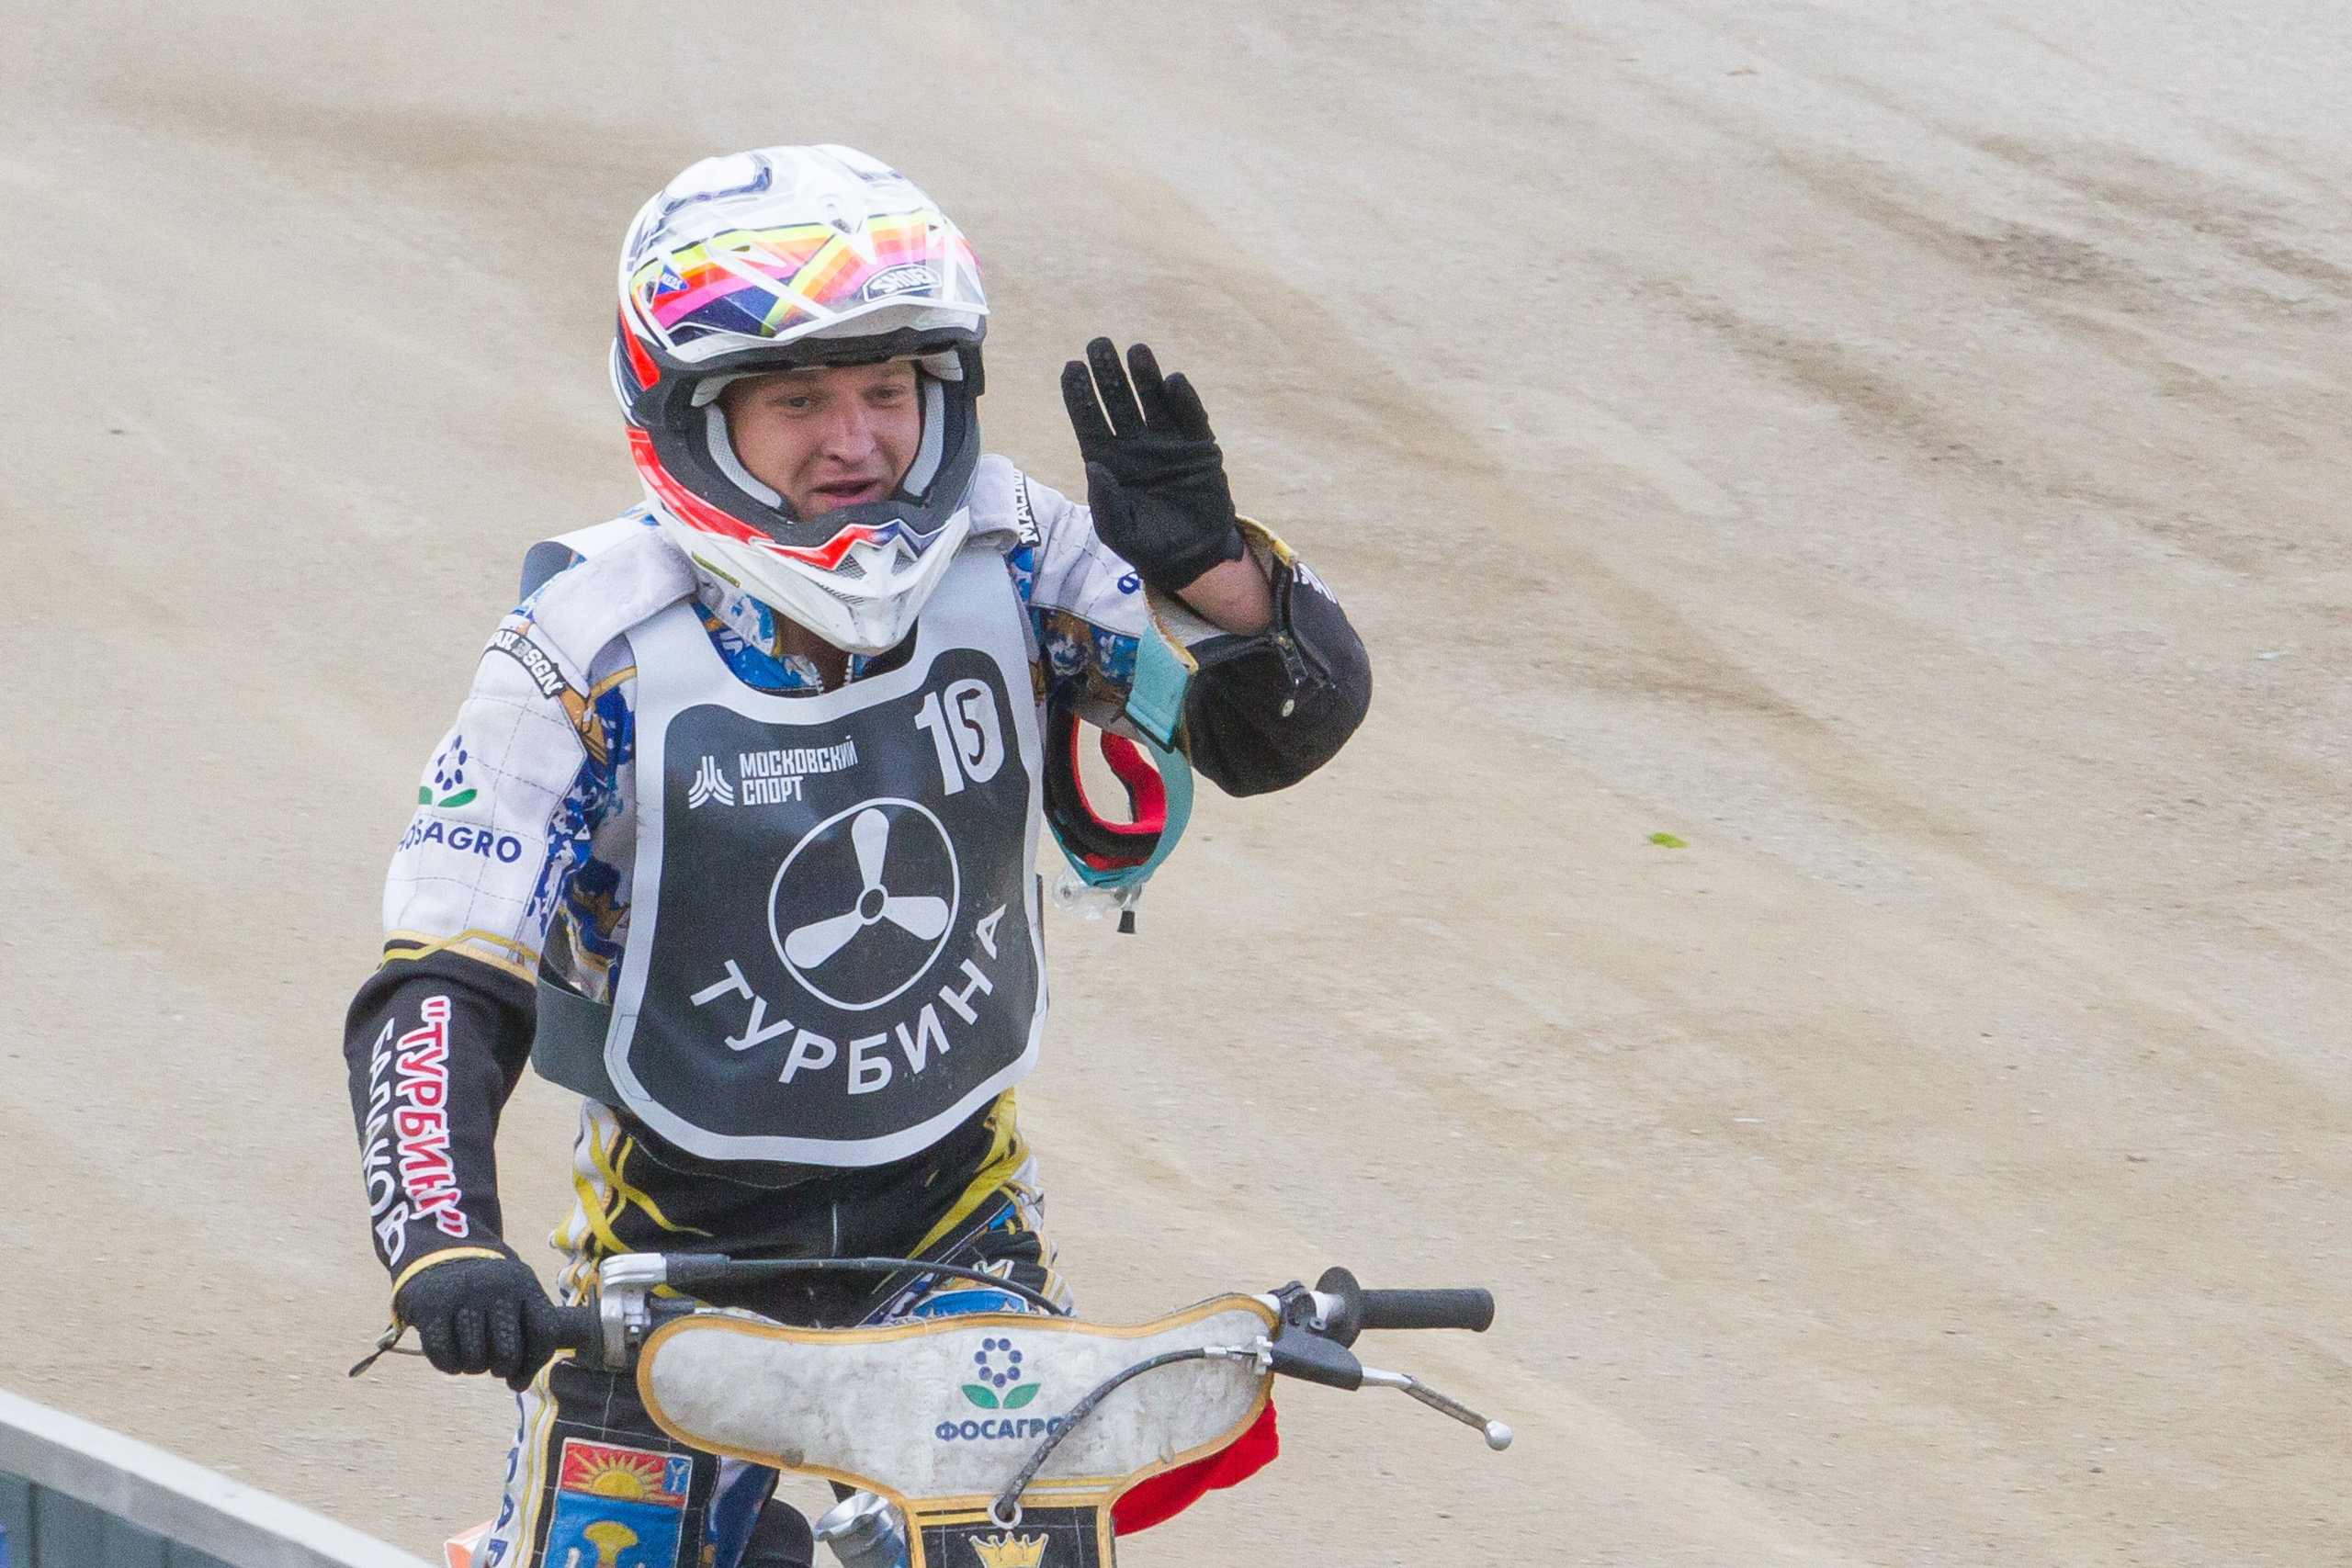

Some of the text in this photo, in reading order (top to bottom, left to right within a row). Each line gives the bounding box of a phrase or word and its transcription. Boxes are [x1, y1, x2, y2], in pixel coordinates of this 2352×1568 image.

[868, 267, 937, 294] SHOEI
[739, 735, 858, 778] МОСКОВСКИЙ
[741, 776, 804, 806] СПОРТ
[398, 818, 522, 863] OSAGRO
[690, 904, 1007, 1095] ТУРБИНА
